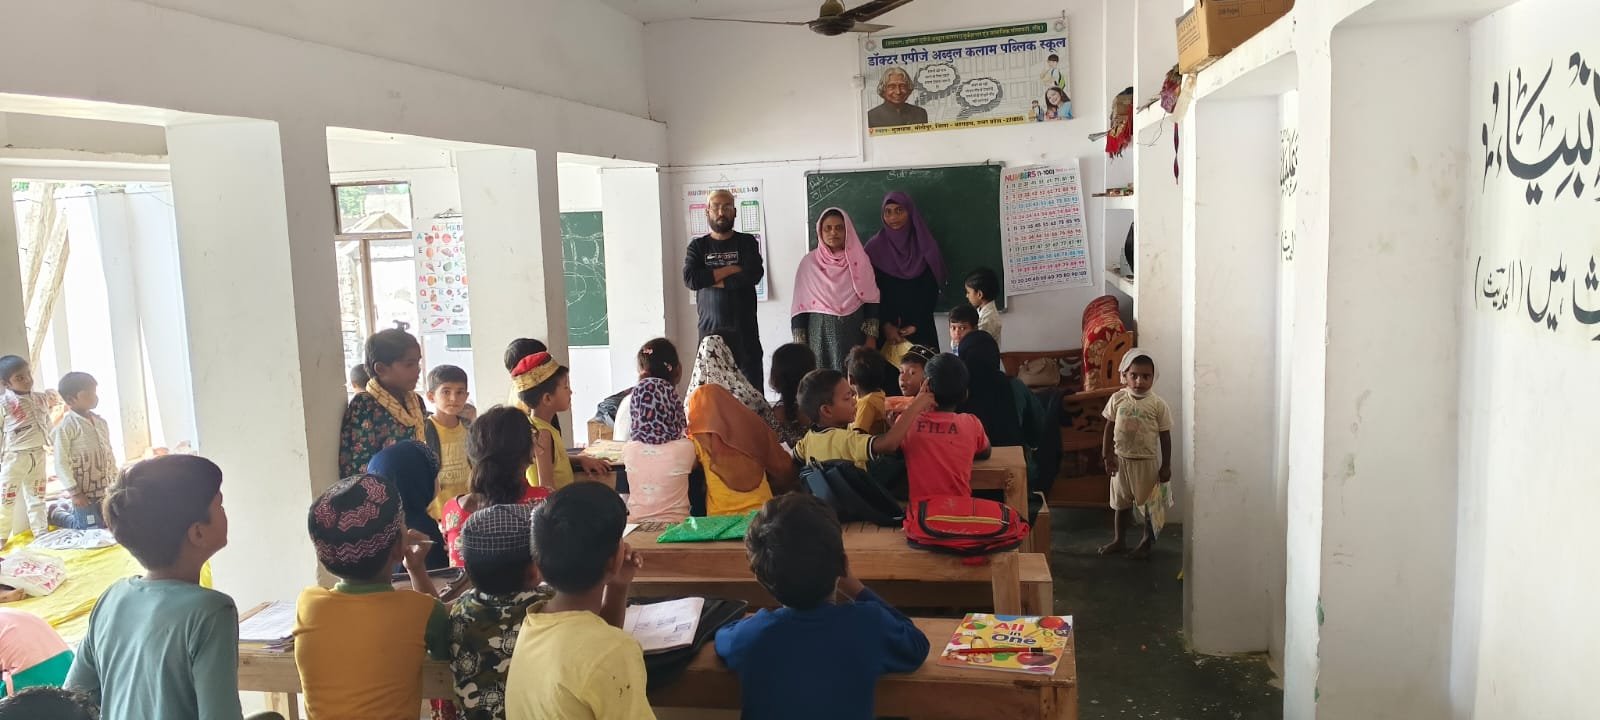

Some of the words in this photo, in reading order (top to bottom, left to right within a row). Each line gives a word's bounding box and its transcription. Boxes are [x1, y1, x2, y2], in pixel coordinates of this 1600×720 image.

[867, 51, 898, 66] डॉक्टर
[901, 50, 928, 64] एपीजे
[932, 48, 962, 63] अब्दुल
[965, 45, 996, 58] कलाम
[1000, 38, 1036, 53] पब्लिक
[1039, 37, 1066, 52] स्कूल
[1005, 171, 1036, 182] NUMBERS
[917, 420, 958, 434] FILA
[994, 622, 1024, 631] All
[992, 634, 1036, 644] One
